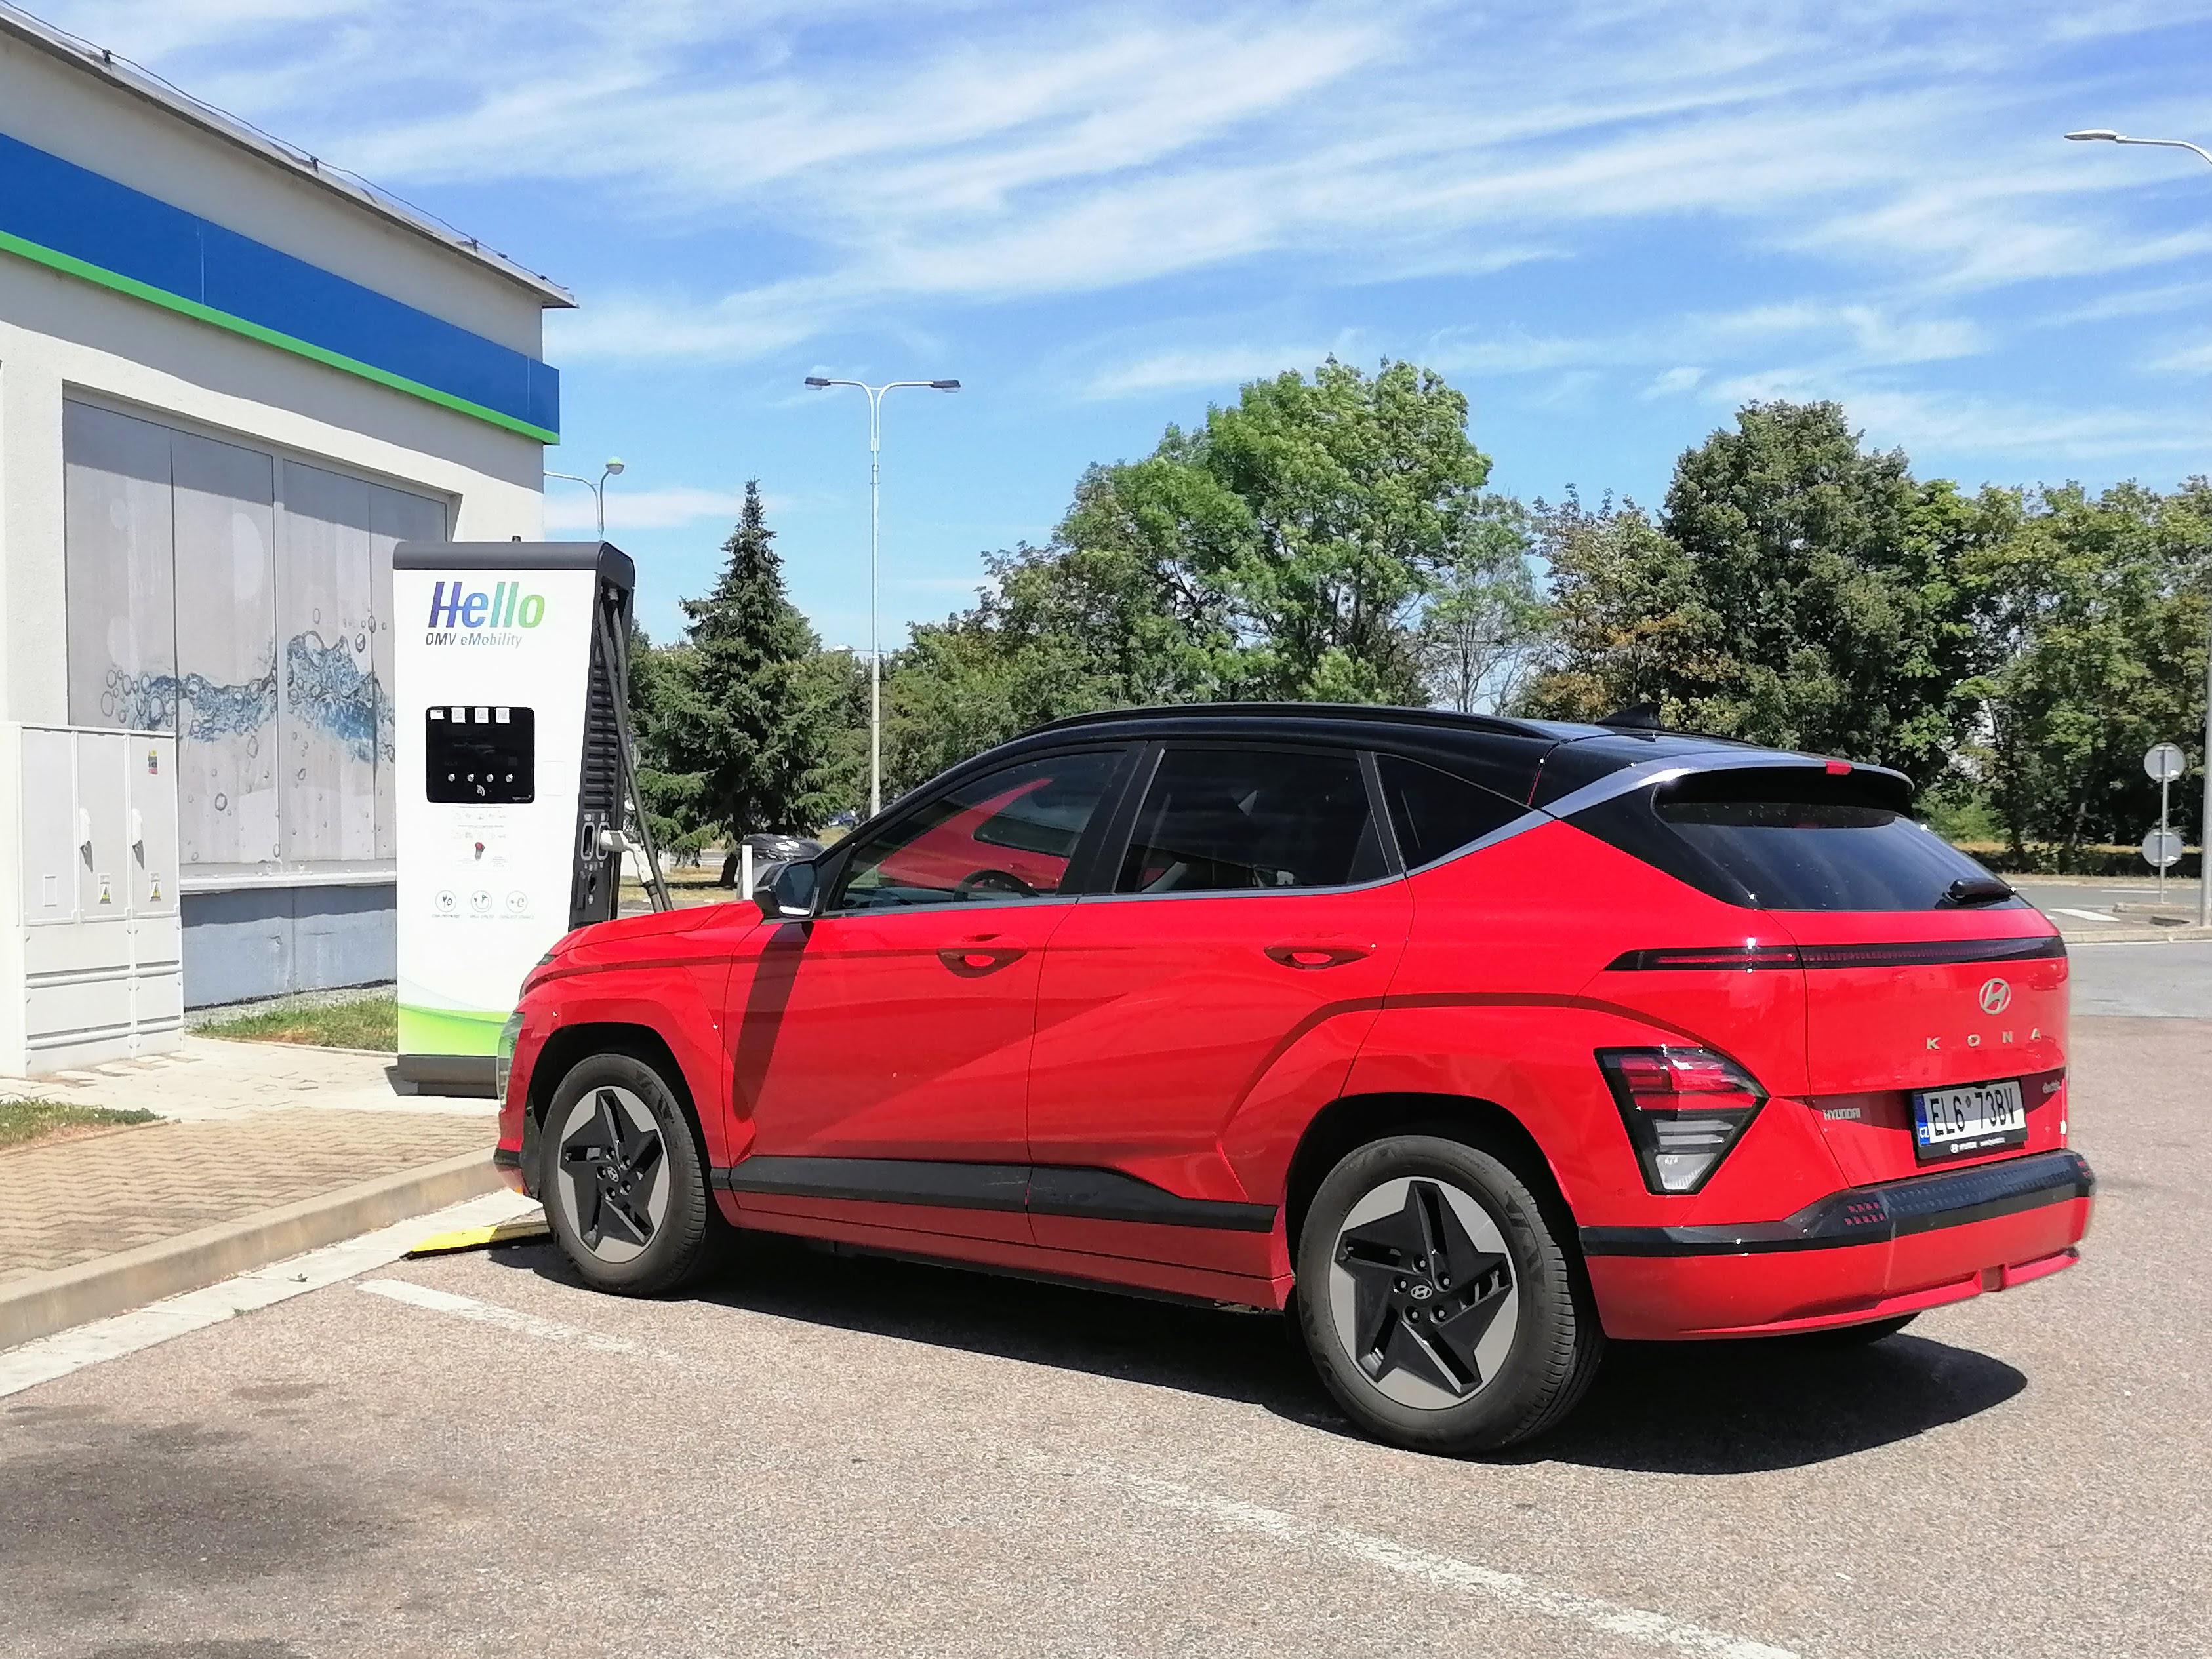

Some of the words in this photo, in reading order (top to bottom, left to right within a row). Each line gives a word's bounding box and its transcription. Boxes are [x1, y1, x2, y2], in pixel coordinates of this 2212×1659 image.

[428, 581, 545, 628] Hello
[426, 633, 457, 646] OMV
[460, 633, 523, 649] eMobility
[1927, 1028, 2041, 1050] KONA
[1930, 1095, 1965, 1137] EL6
